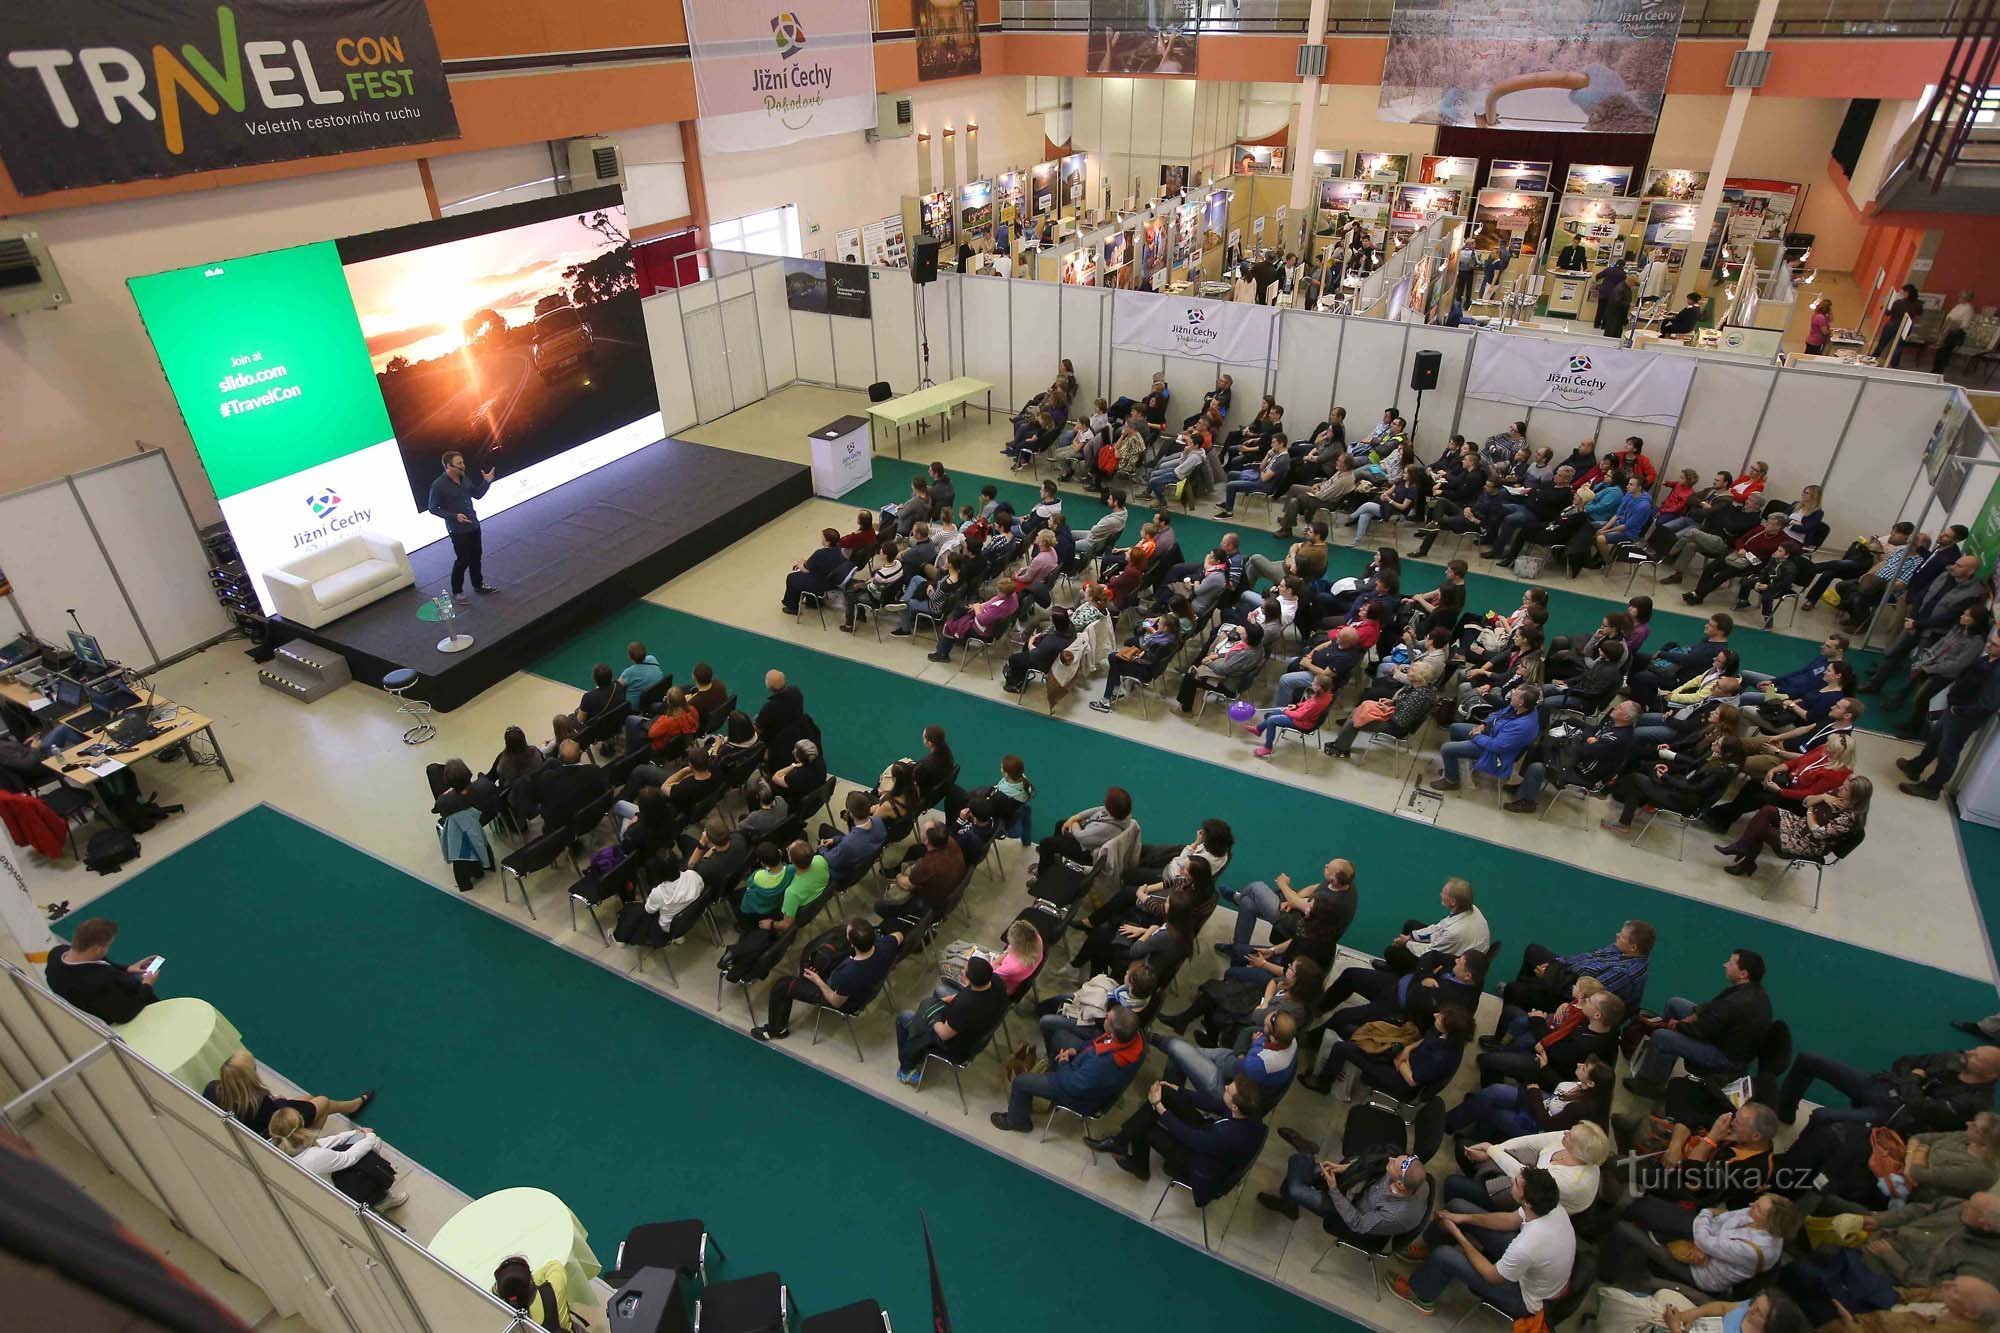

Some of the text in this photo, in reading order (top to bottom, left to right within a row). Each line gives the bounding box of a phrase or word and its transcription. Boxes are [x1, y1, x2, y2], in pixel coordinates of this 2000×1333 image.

[336, 35, 405, 67] CON
[8, 4, 344, 155] TRAVEL
[346, 68, 414, 101] FEST
[752, 63, 832, 91] Jižní Čechy
[245, 106, 421, 136] Veletrh cestovního ruchu
[230, 351, 263, 368] Join at
[218, 364, 288, 393] slido.com
[219, 385, 303, 418] #TravelCon
